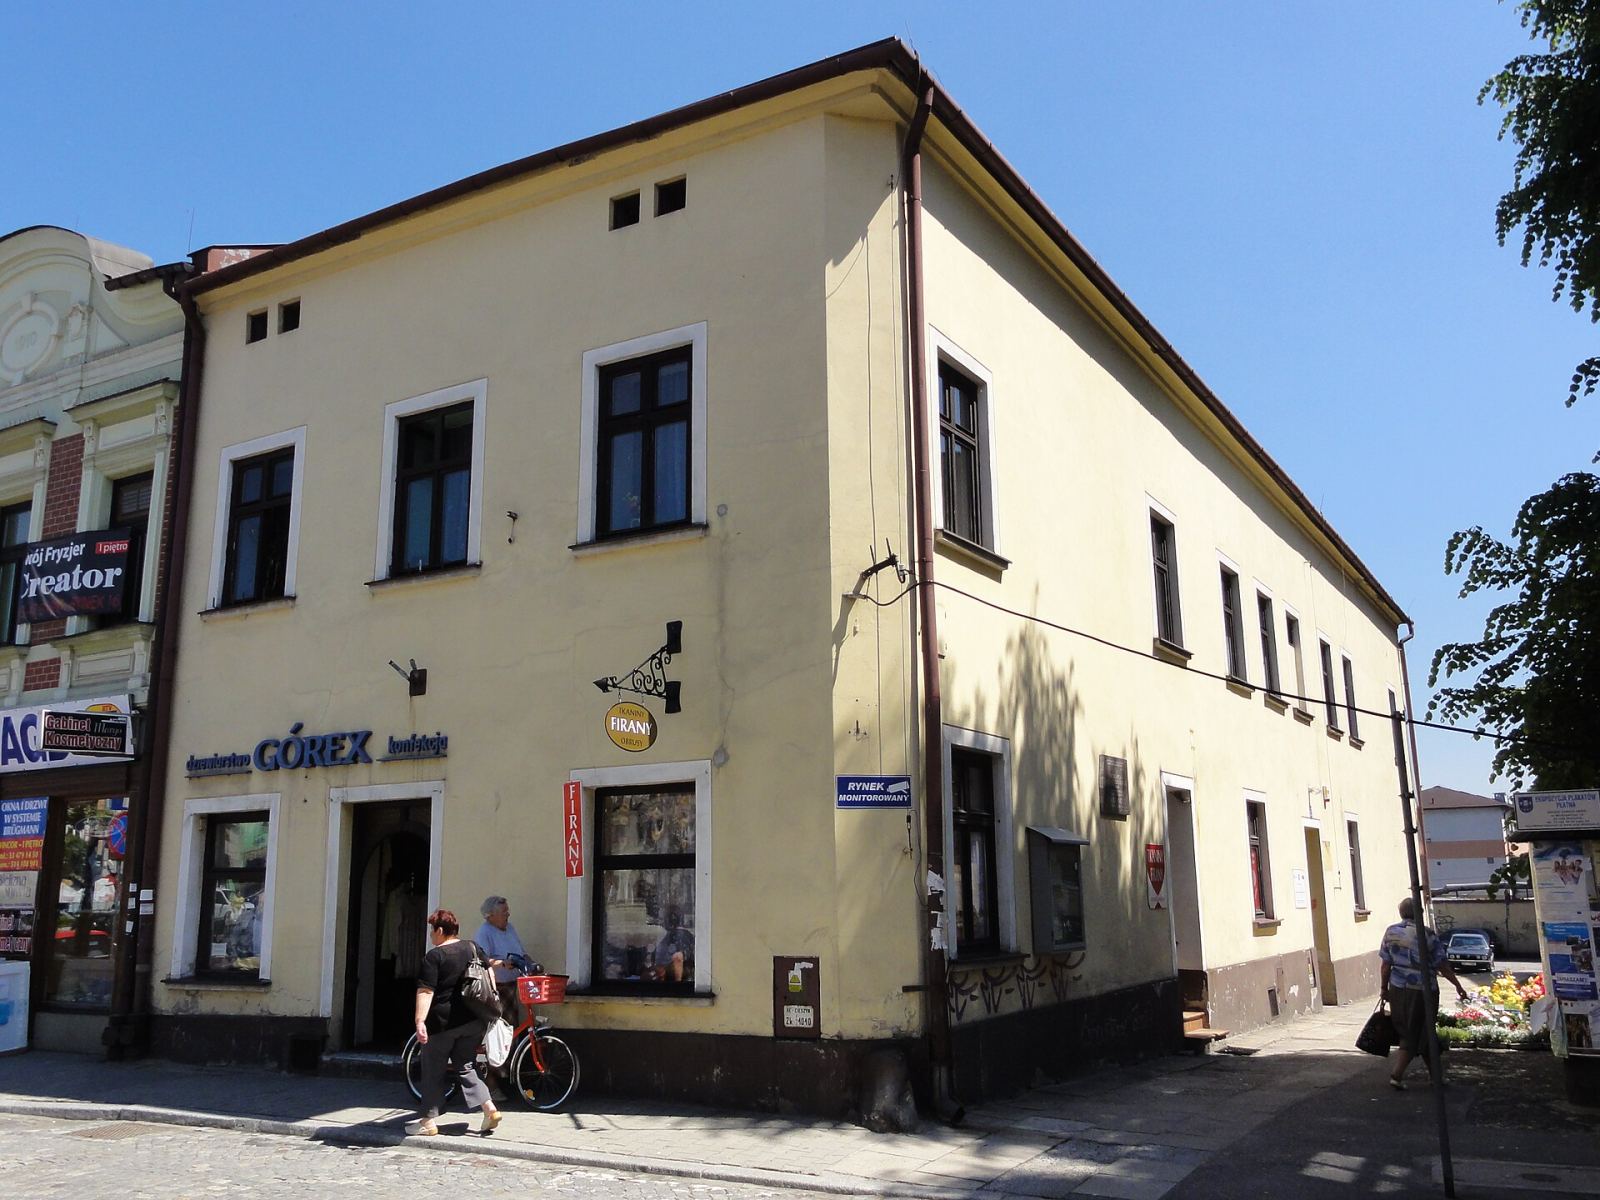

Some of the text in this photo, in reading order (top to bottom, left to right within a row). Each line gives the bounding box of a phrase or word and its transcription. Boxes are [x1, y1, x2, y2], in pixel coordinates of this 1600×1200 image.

[45, 542, 86, 564] Fryzjer
[103, 542, 128, 554] piętro
[46, 714, 91, 732] Gabinet
[611, 716, 653, 736] FIRANY
[45, 731, 121, 750] Kosmetyczny
[186, 722, 448, 772] dziewiarstwo GÓREX konfekcja
[848, 782, 885, 791] RYNEK
[1, 801, 20, 812] OKNA
[838, 794, 910, 802] MONITOROWANY
[4, 812, 41, 824] W SYSTEMIE
[568, 784, 580, 876] FIRANY
